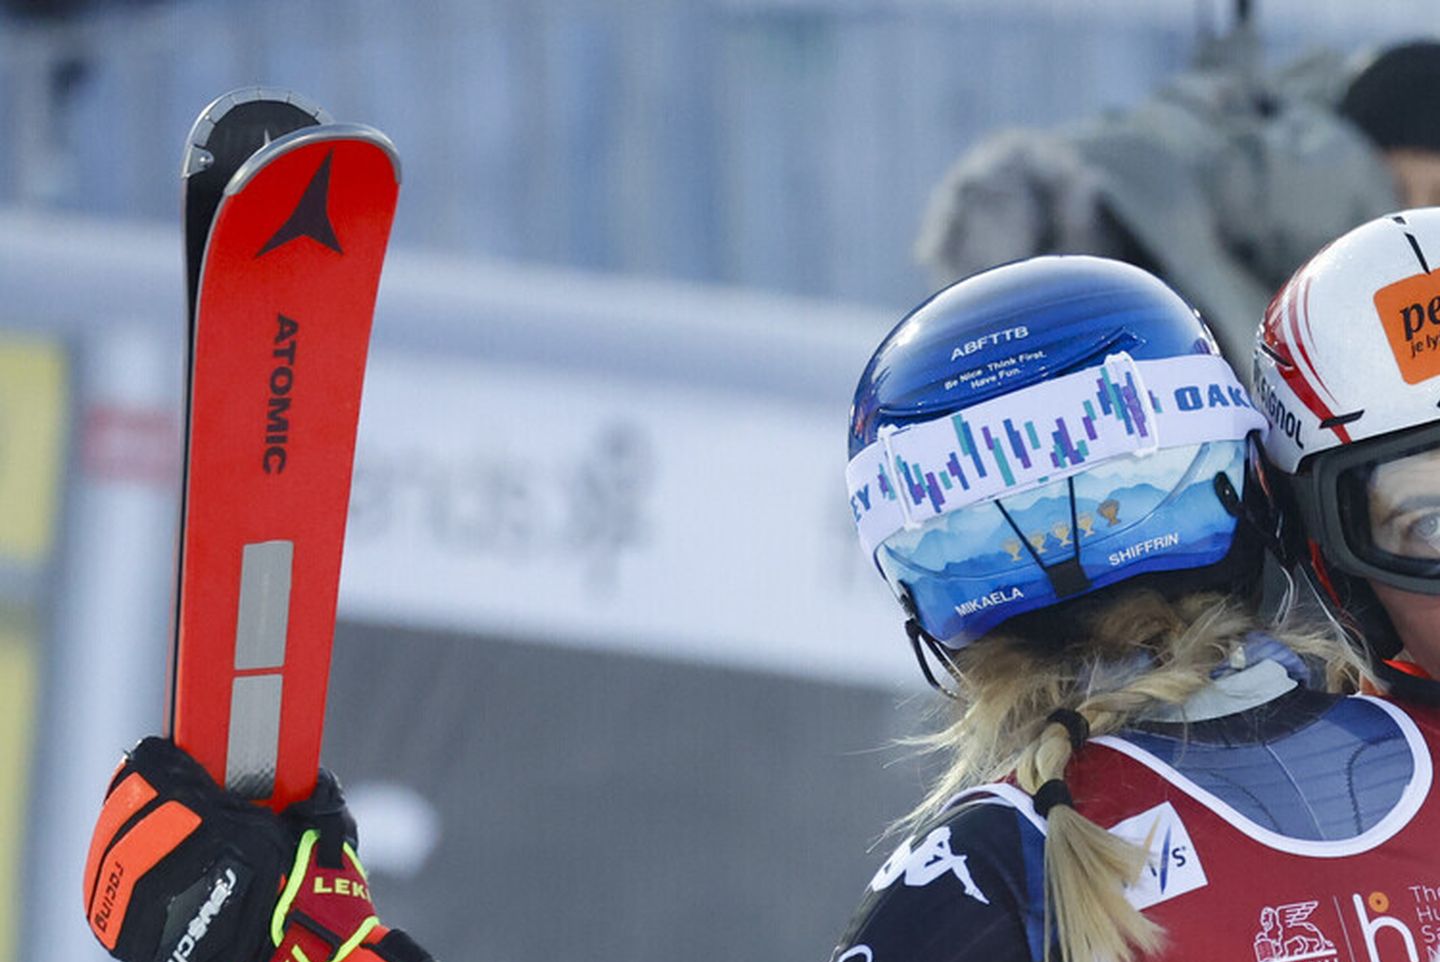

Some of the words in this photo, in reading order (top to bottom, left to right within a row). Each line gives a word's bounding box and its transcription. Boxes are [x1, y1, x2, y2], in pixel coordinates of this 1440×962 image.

[950, 326, 1029, 361] ABFTTB
[1409, 340, 1424, 358] je
[262, 313, 300, 475] ATOMIC
[1174, 383, 1249, 412] OAK
[1108, 532, 1180, 567] SHIFFRIN
[955, 587, 1024, 617] MIKAELA
[94, 861, 124, 933] racing
[313, 877, 371, 901] LEK
